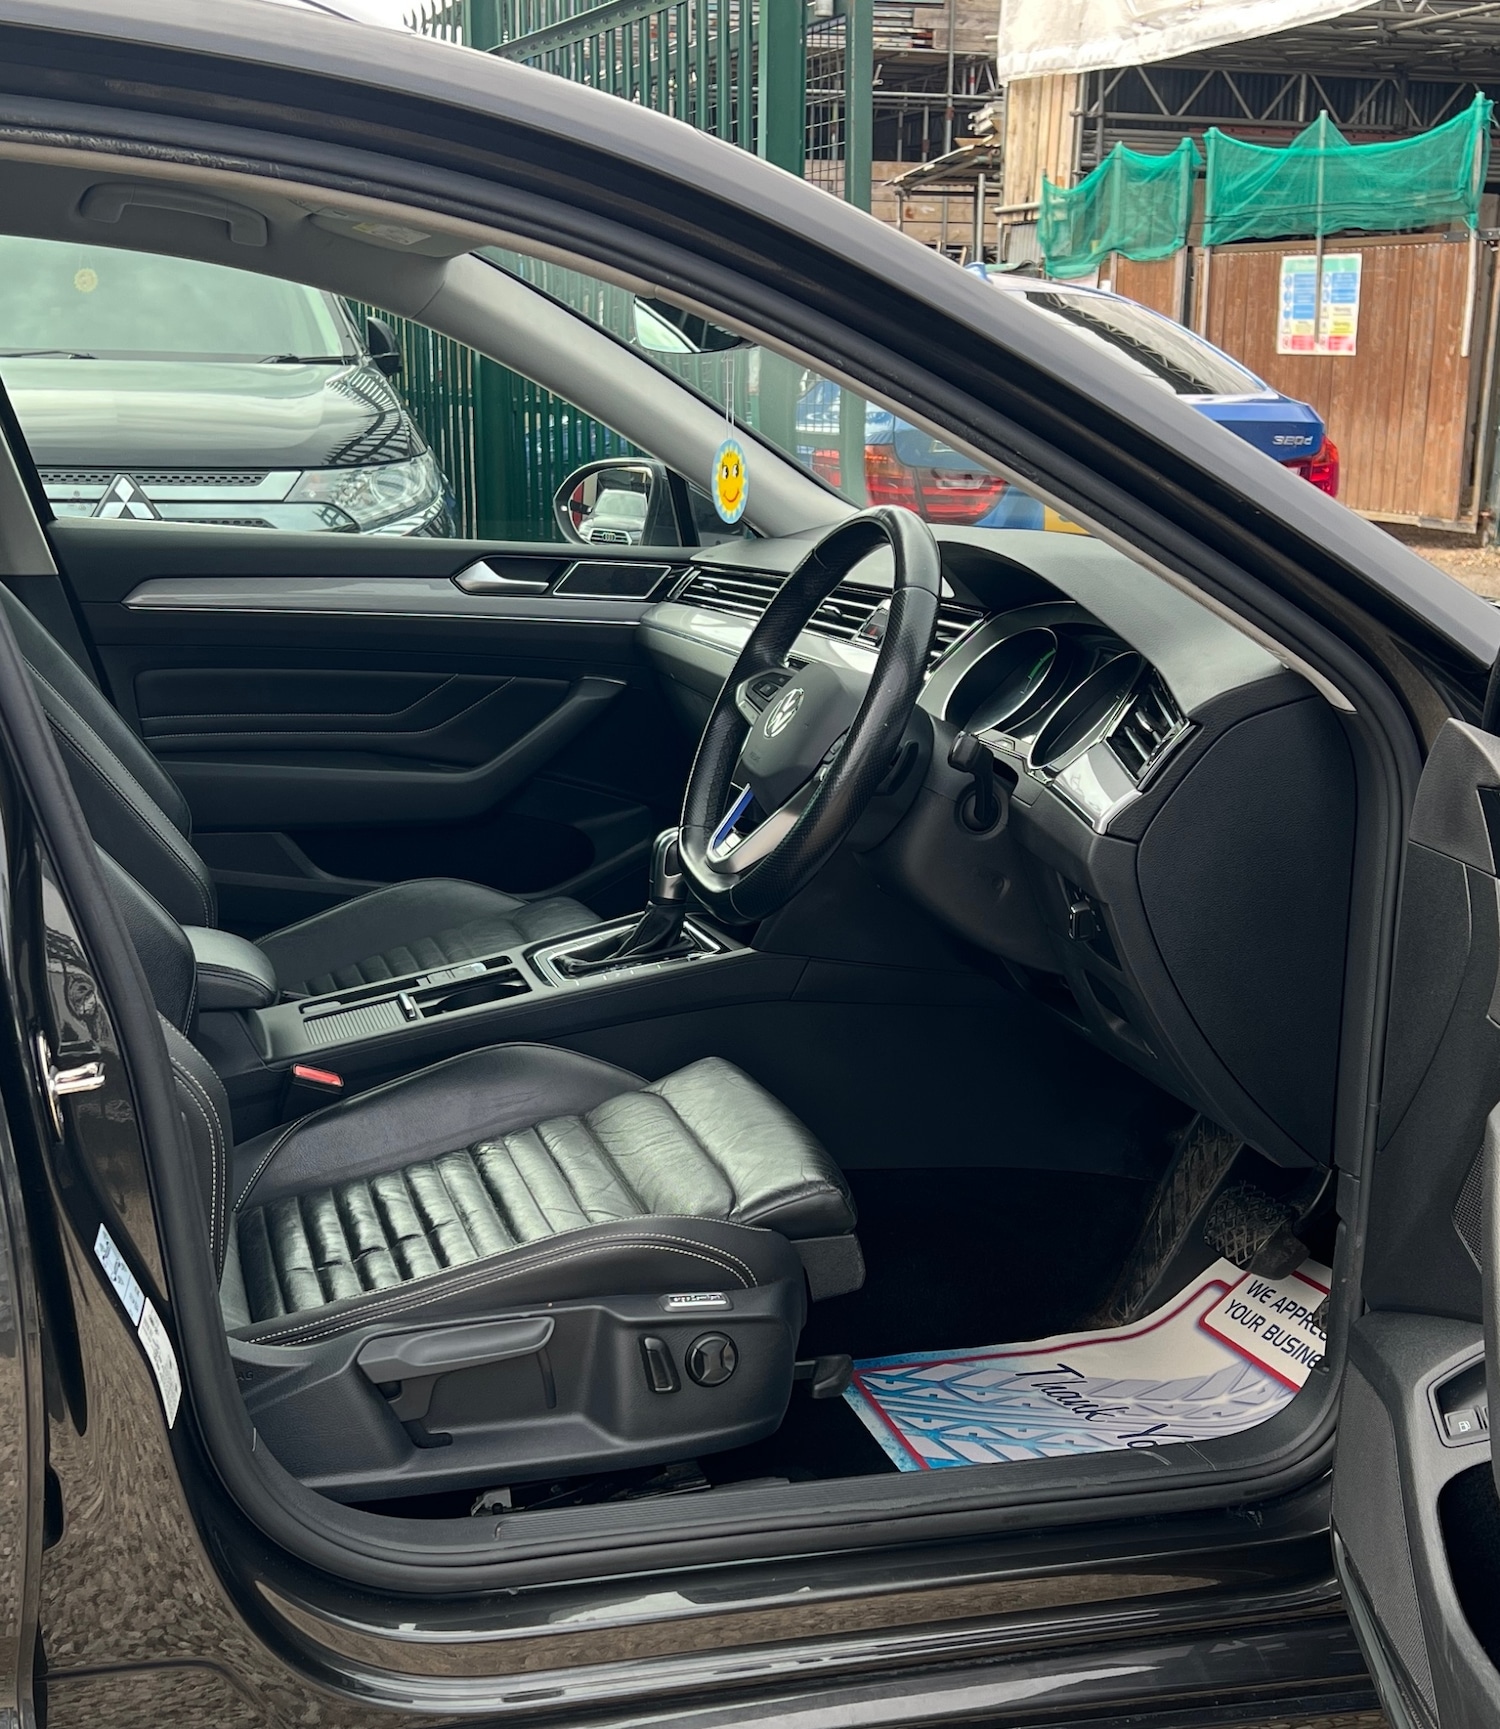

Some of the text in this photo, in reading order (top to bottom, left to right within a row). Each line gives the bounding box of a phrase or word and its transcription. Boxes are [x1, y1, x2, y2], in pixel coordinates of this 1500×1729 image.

[1272, 435, 1314, 446] 320d
[1246, 1279, 1277, 1304] WE
[1224, 1299, 1267, 1333] YOUR
[1015, 1362, 1130, 1423] Thank
